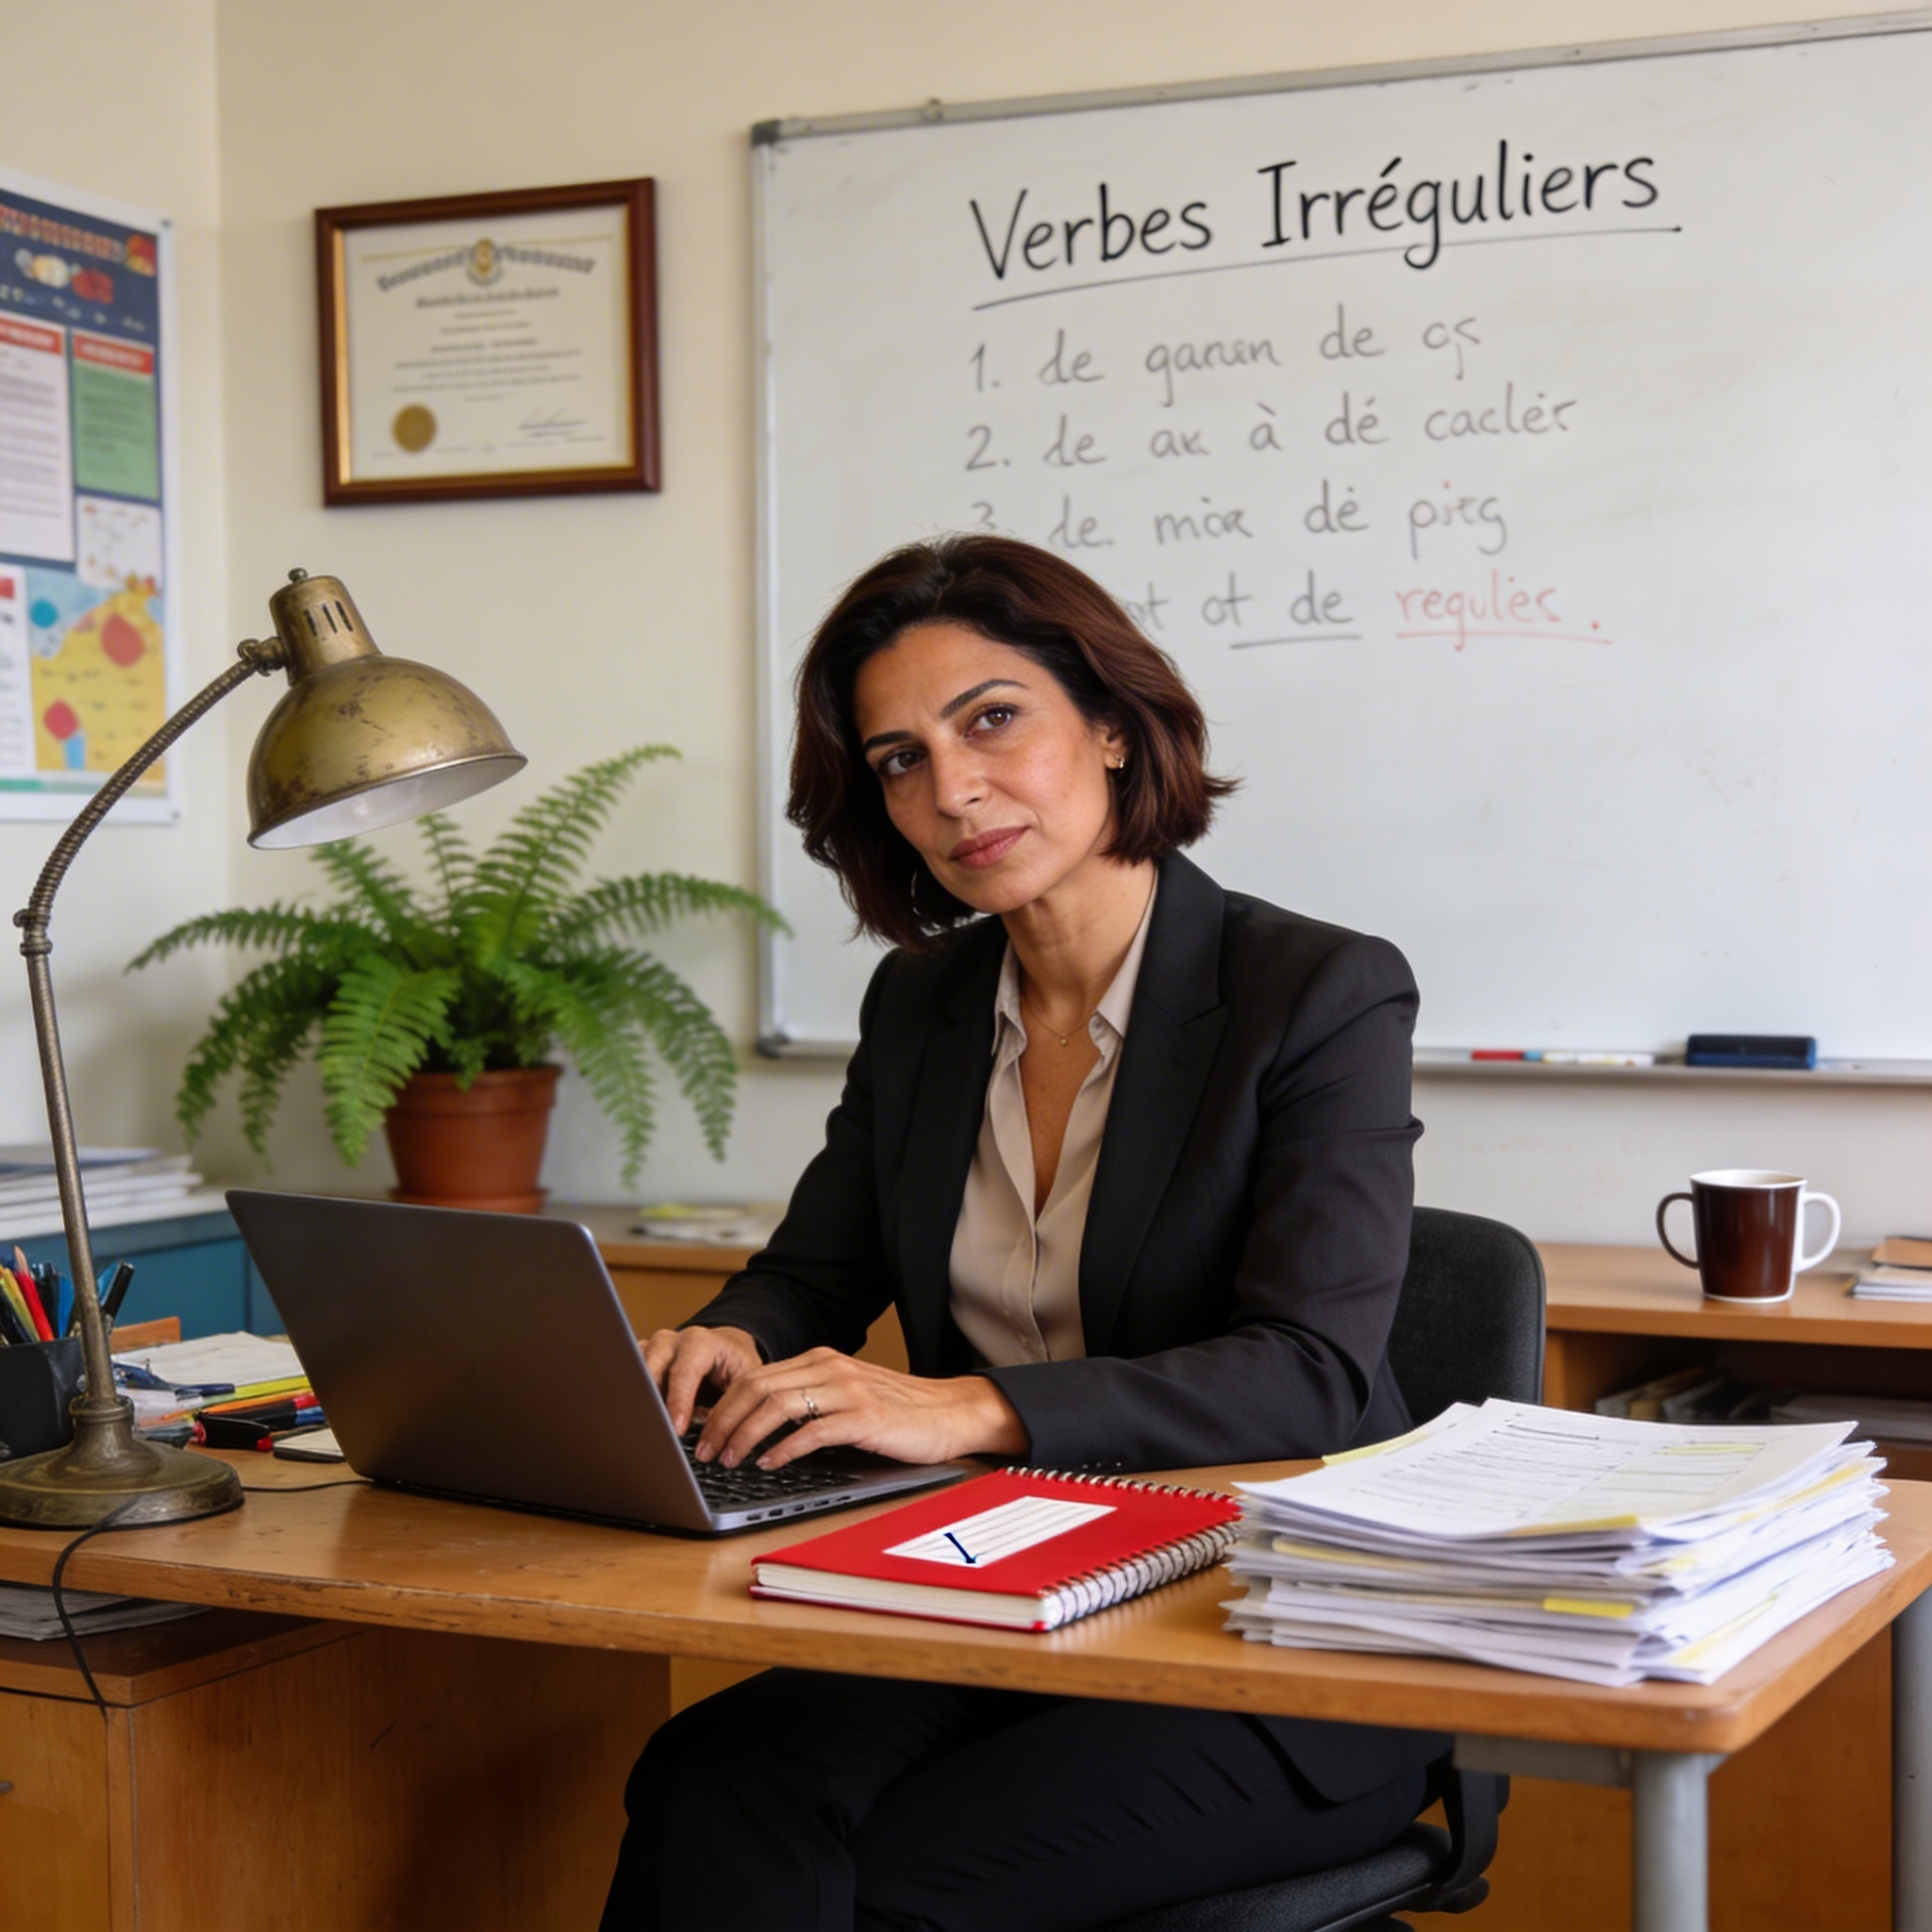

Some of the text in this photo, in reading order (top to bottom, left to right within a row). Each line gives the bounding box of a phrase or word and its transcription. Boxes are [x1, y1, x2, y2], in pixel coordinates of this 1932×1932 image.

[970, 138, 1660, 281] Verbes Irréguliers
[969, 342, 1000, 392] 1.
[1319, 303, 1387, 359] de
[963, 423, 1011, 472] 2.
[1249, 402, 1283, 452] à
[1324, 391, 1391, 445] dé
[1290, 568, 1355, 625] de
